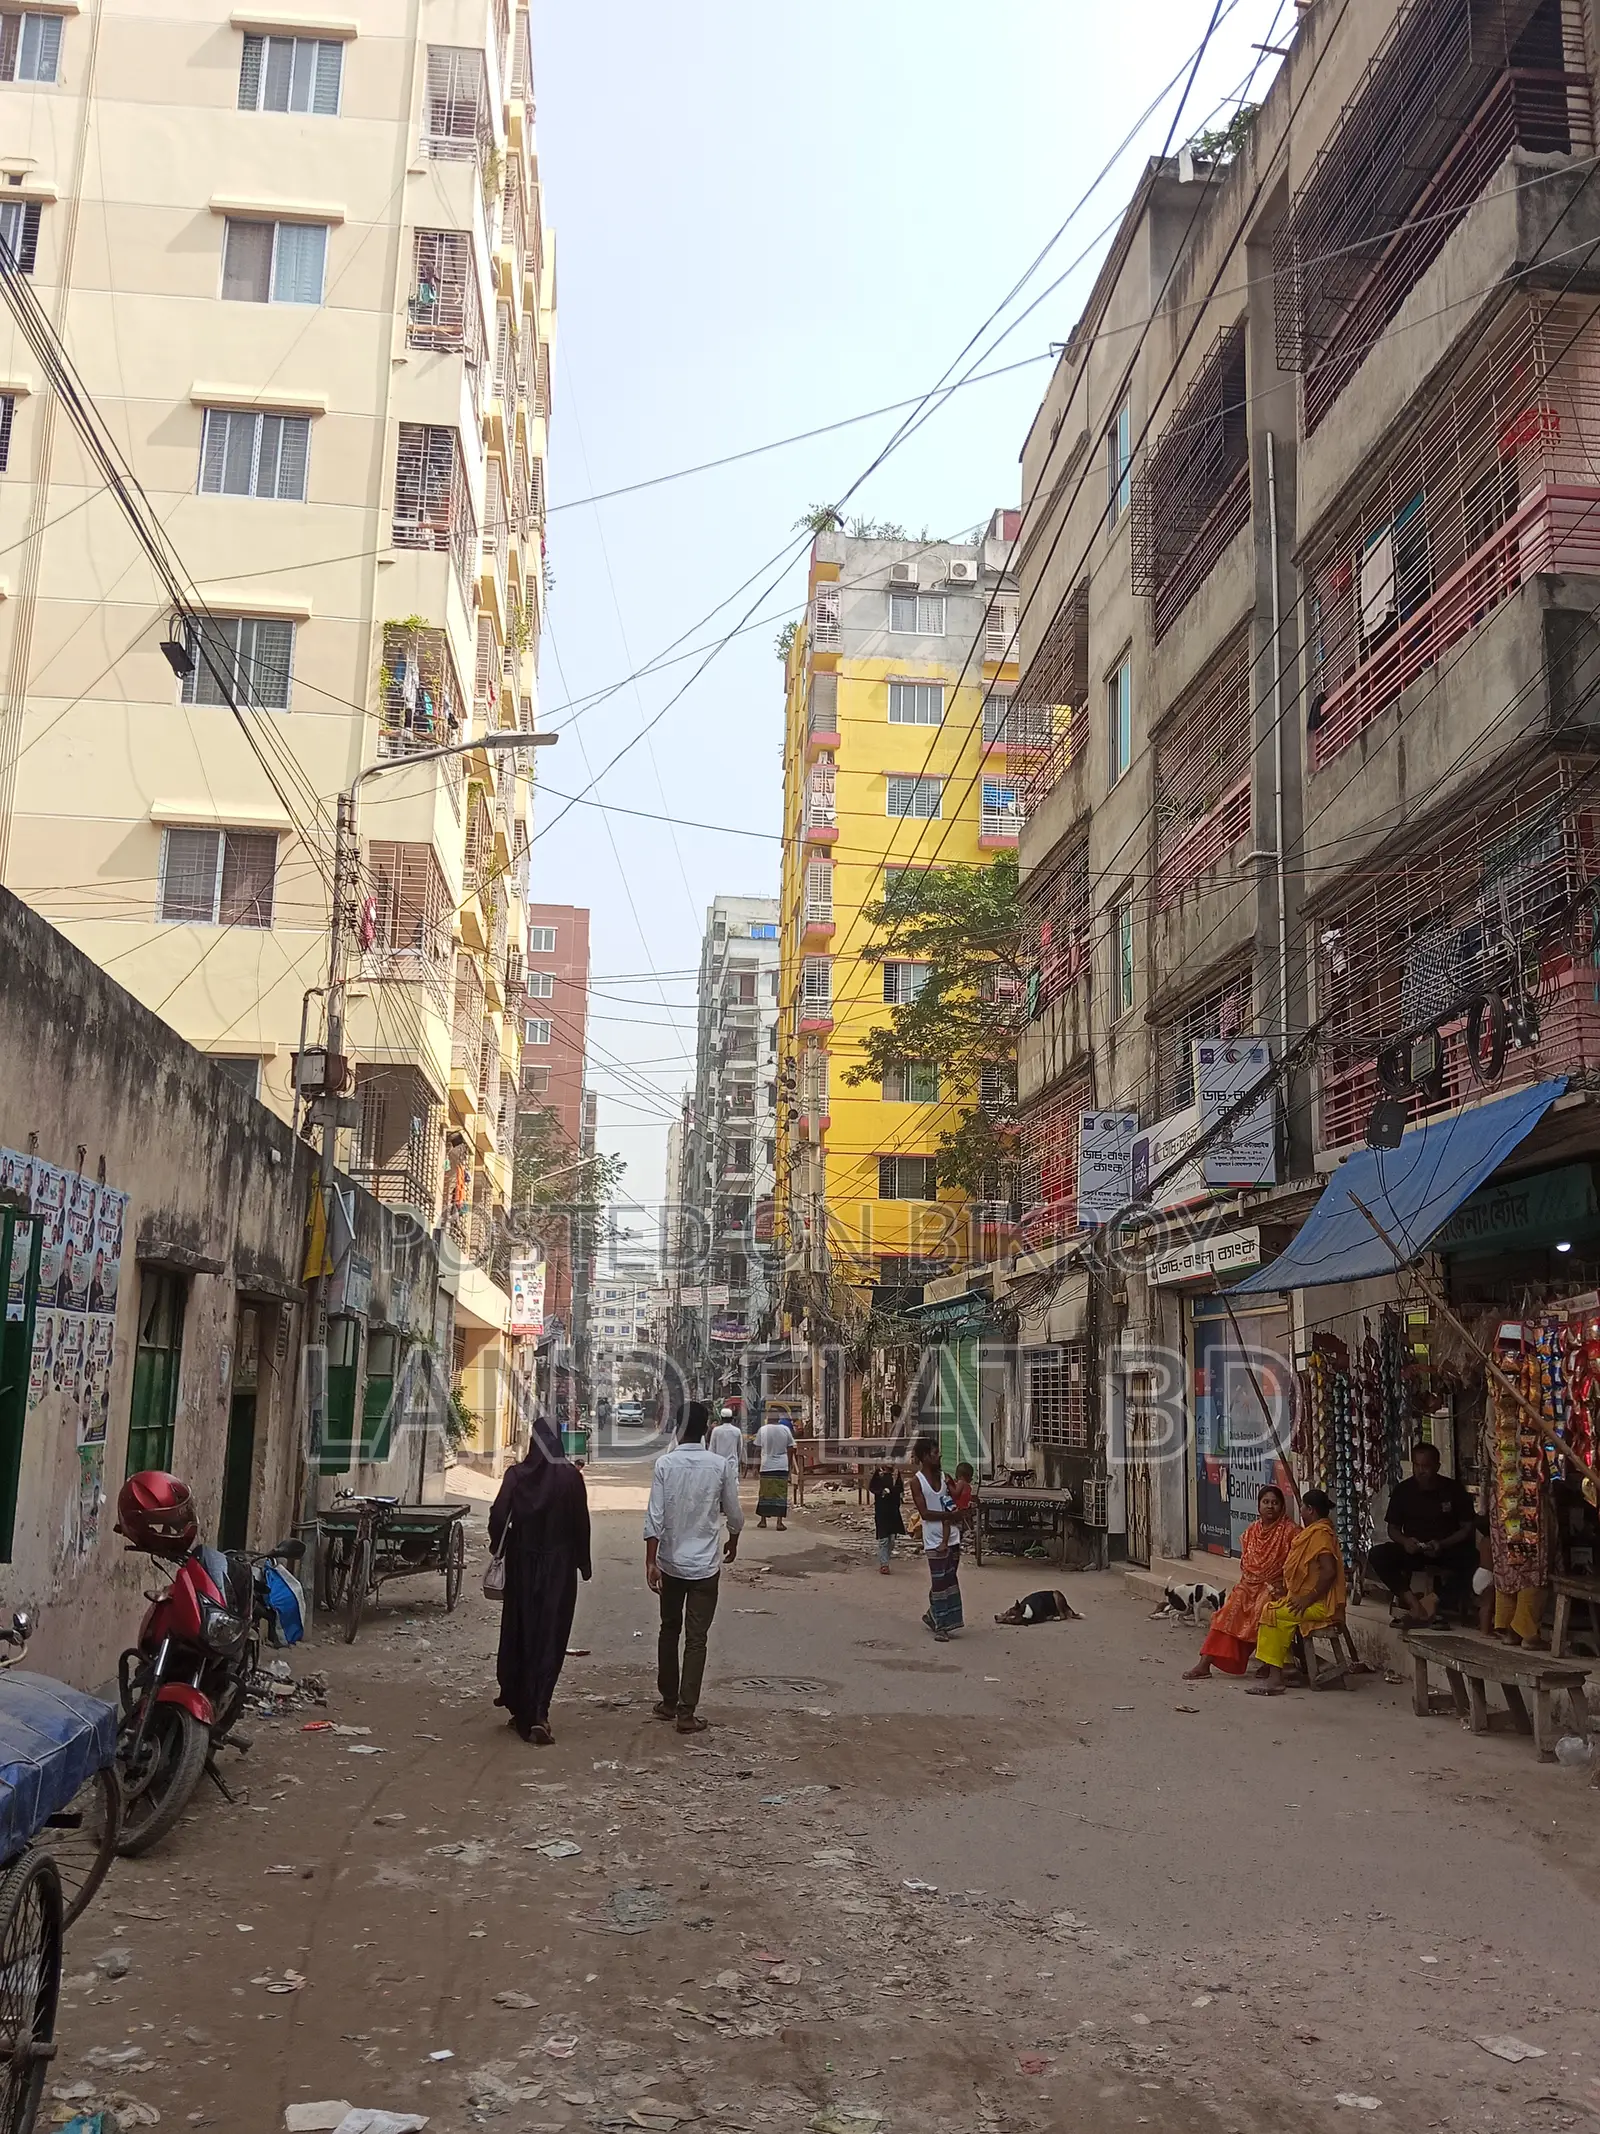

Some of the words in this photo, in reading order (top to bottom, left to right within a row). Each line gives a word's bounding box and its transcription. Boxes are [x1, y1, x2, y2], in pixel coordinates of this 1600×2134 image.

[1217, 1239, 1256, 1261] ব্যাংক
[1230, 1446, 1264, 1472] AGENT
[1230, 1474, 1265, 1500] Bankin
